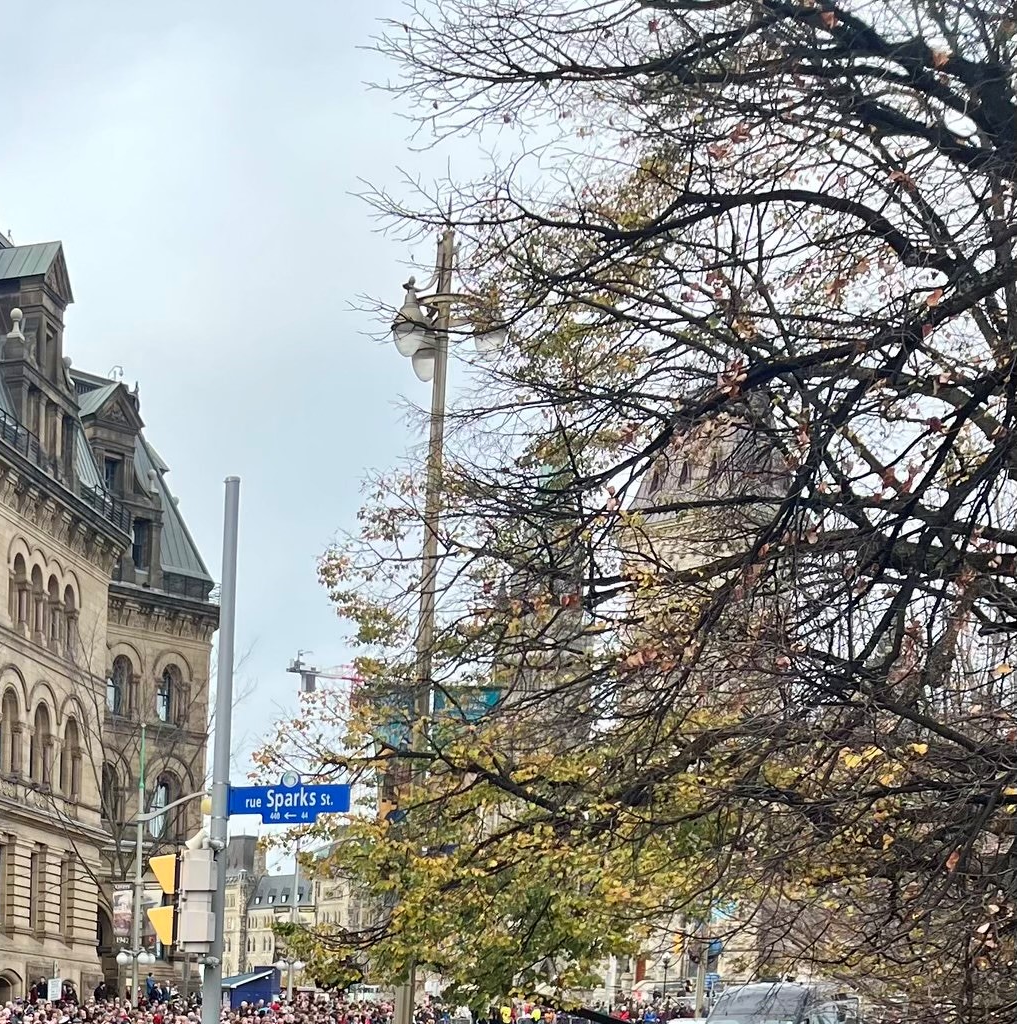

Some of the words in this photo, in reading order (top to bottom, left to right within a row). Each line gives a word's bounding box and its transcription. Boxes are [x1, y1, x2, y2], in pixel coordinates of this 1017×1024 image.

[245, 797, 262, 808] rue
[266, 787, 317, 812] Sparks
[320, 793, 334, 806] St.
[301, 811, 309, 819] 44
[116, 936, 129, 944] 1942
